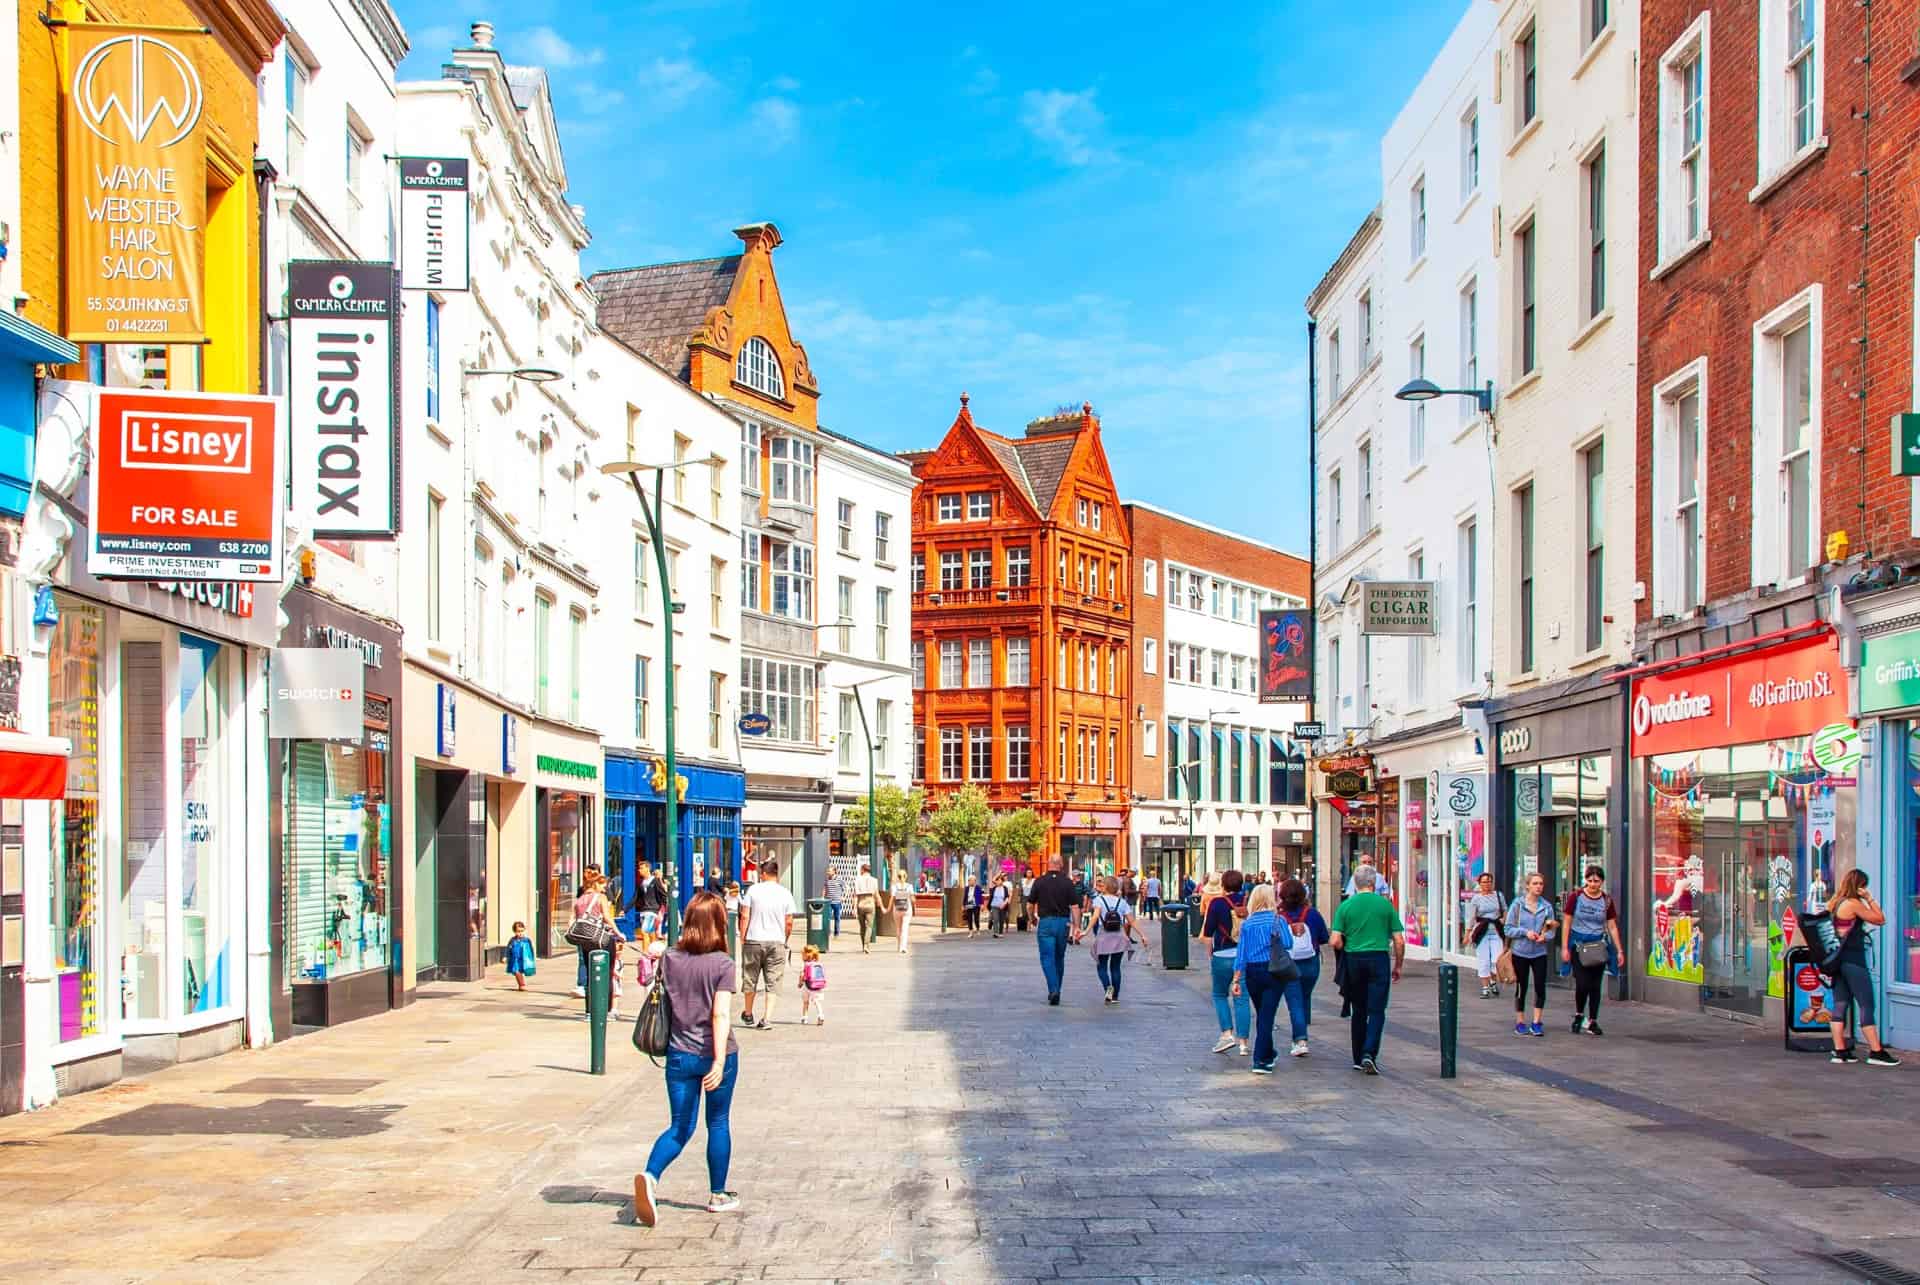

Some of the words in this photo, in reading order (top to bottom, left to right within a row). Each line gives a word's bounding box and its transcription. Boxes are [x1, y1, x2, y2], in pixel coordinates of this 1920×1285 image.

[95, 163, 176, 193] WAYNE
[405, 175, 435, 186] CAMERA
[436, 176, 465, 187] CENTRE
[84, 196, 198, 231] WEBSTER
[110, 226, 172, 256] HAIR
[426, 194, 443, 284] FUJIFILM
[102, 255, 174, 280] SALON
[294, 298, 342, 312] CAMERA
[342, 299, 387, 313] CENTRE
[106, 318, 120, 332] 01
[317, 333, 375, 517] instax
[131, 421, 242, 464] Lisney
[131, 505, 176, 525] FOR
[181, 507, 238, 527] SALE
[101, 538, 191, 553] www.lisney.com
[219, 542, 239, 554] 638
[241, 543, 269, 555] 2700
[109, 556, 145, 567] PRIME
[148, 556, 221, 569] INVESTMENT
[125, 566, 153, 576] Tenant
[155, 567, 170, 576] Not
[171, 568, 207, 577] Affected
[1370, 590, 1388, 598] THE
[1391, 589, 1429, 598] DECENT
[1370, 601, 1429, 614] CIGAR
[1370, 616, 1429, 625] EMPORIUM
[278, 687, 340, 700] swatch
[1749, 683, 1765, 708] 48
[1766, 676, 1813, 706] Grafton
[1814, 671, 1835, 697] St.
[1651, 691, 1713, 725] vodafone
[1294, 725, 1321, 737] VANS
[1502, 727, 1529, 754] ecco
[1448, 777, 1477, 813] 3
